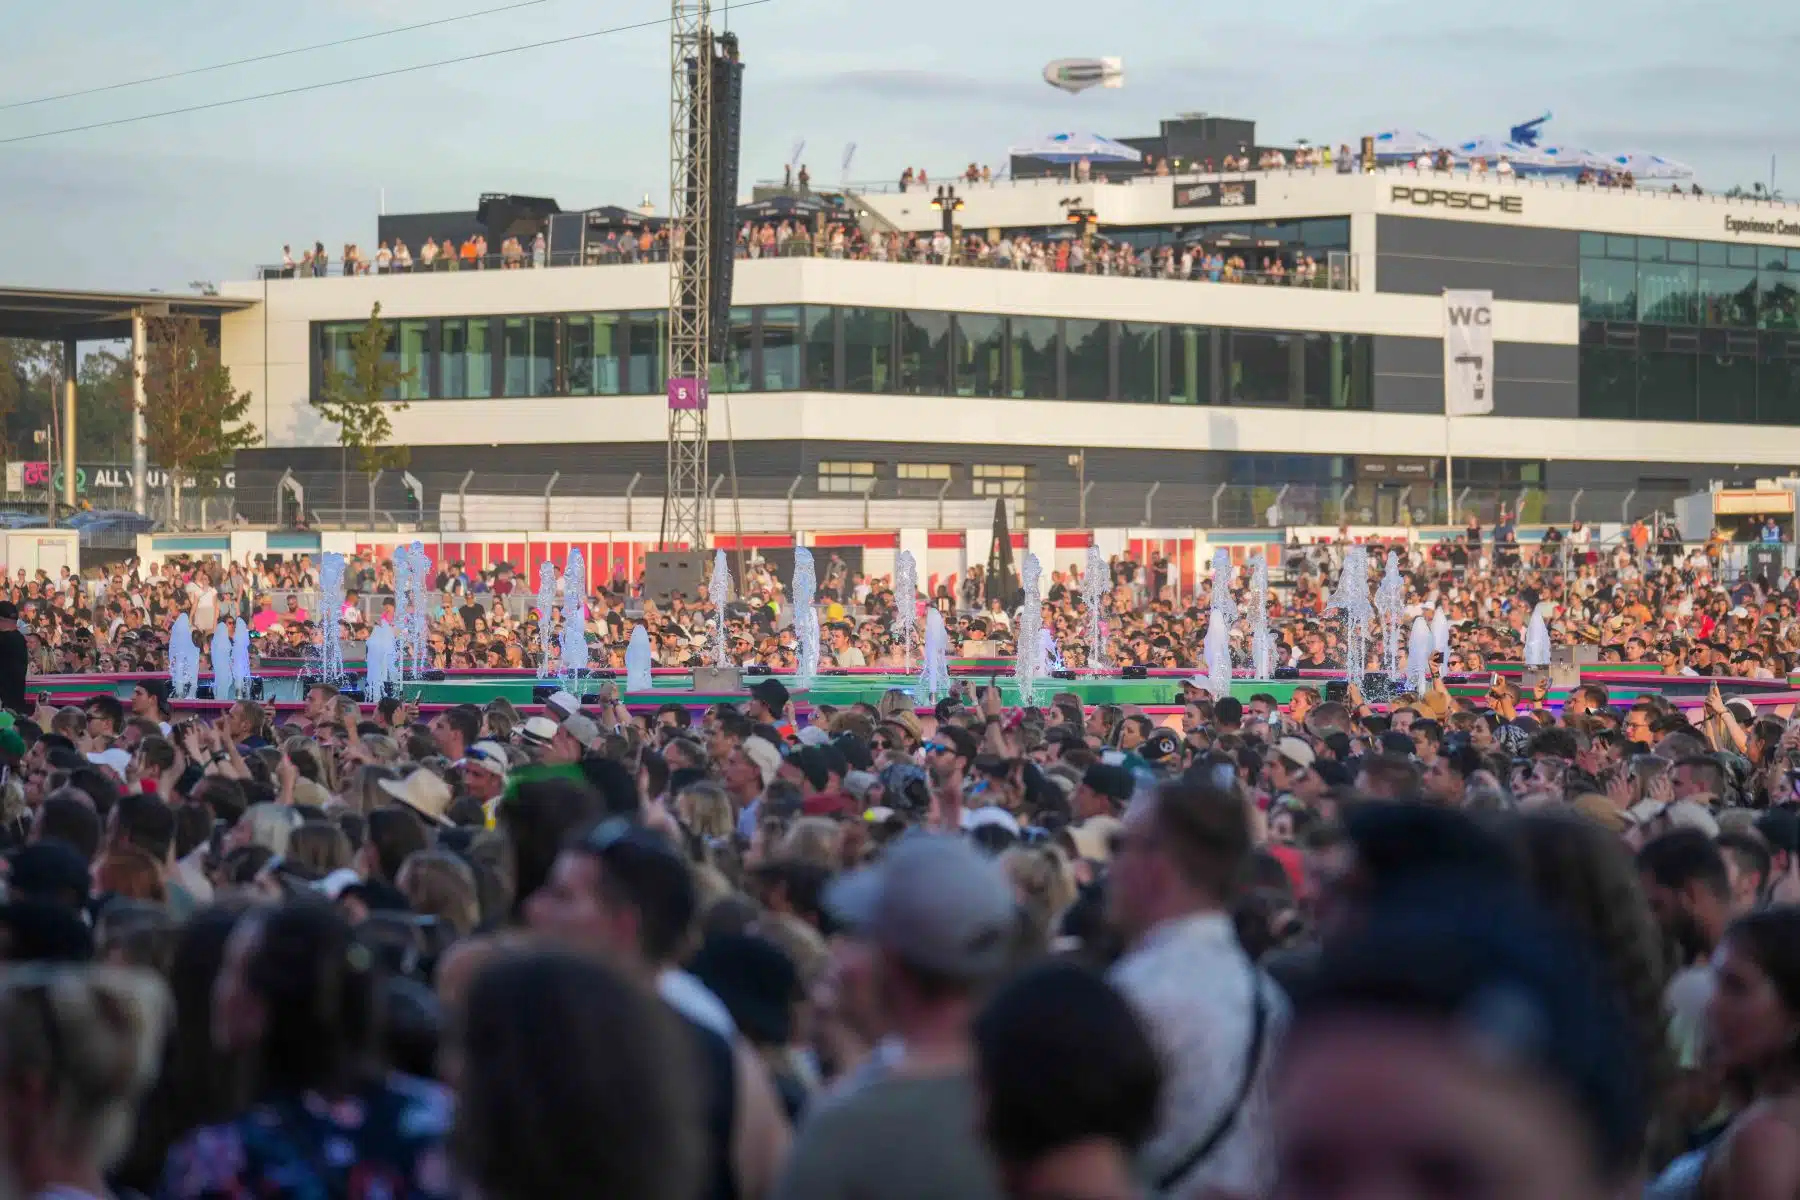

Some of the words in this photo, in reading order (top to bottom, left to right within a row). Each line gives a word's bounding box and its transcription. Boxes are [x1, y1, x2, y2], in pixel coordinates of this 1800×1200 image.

[1391, 186, 1523, 213] PORSCHE
[1725, 214, 1775, 235] Experience
[1448, 306, 1491, 326] WC
[678, 387, 687, 400] 5
[94, 469, 124, 487] ALL
[125, 469, 159, 488] YU
